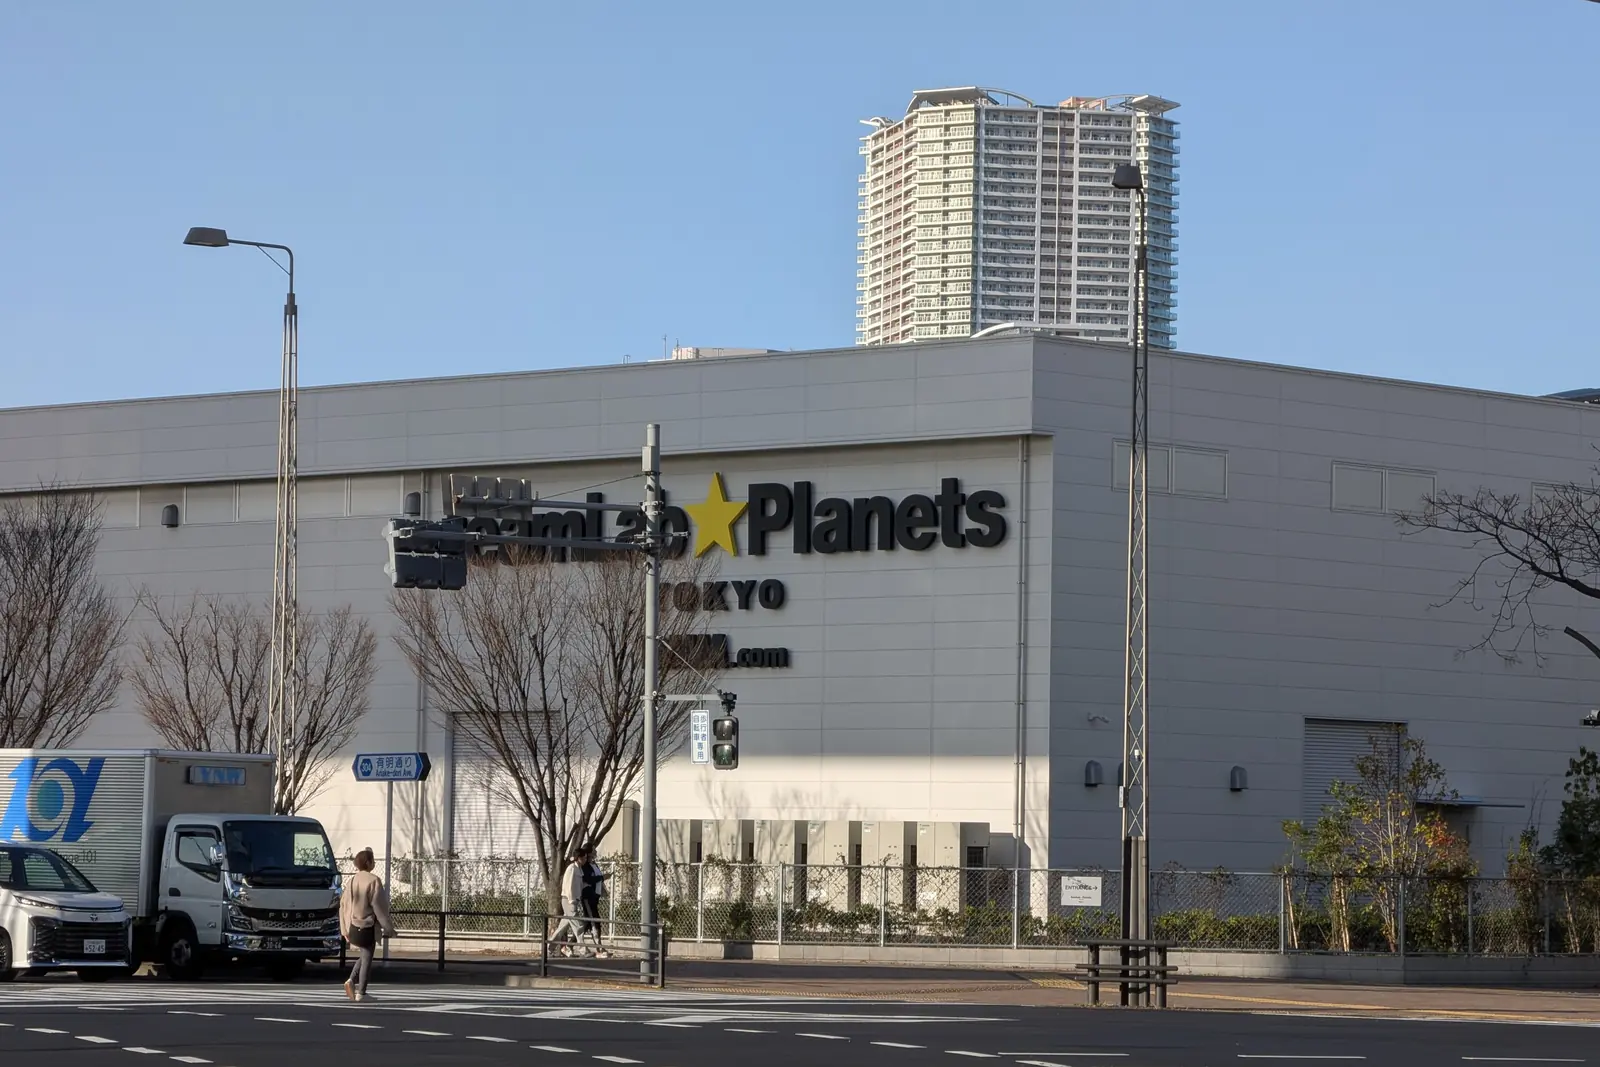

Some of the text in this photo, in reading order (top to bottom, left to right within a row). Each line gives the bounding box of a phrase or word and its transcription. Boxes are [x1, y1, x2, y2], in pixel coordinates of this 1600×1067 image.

[459, 477, 1007, 566] eamLab Planets
[361, 763, 372, 772] 304
[376, 756, 412, 769] 有明通り
[268, 911, 316, 919] FUSO
